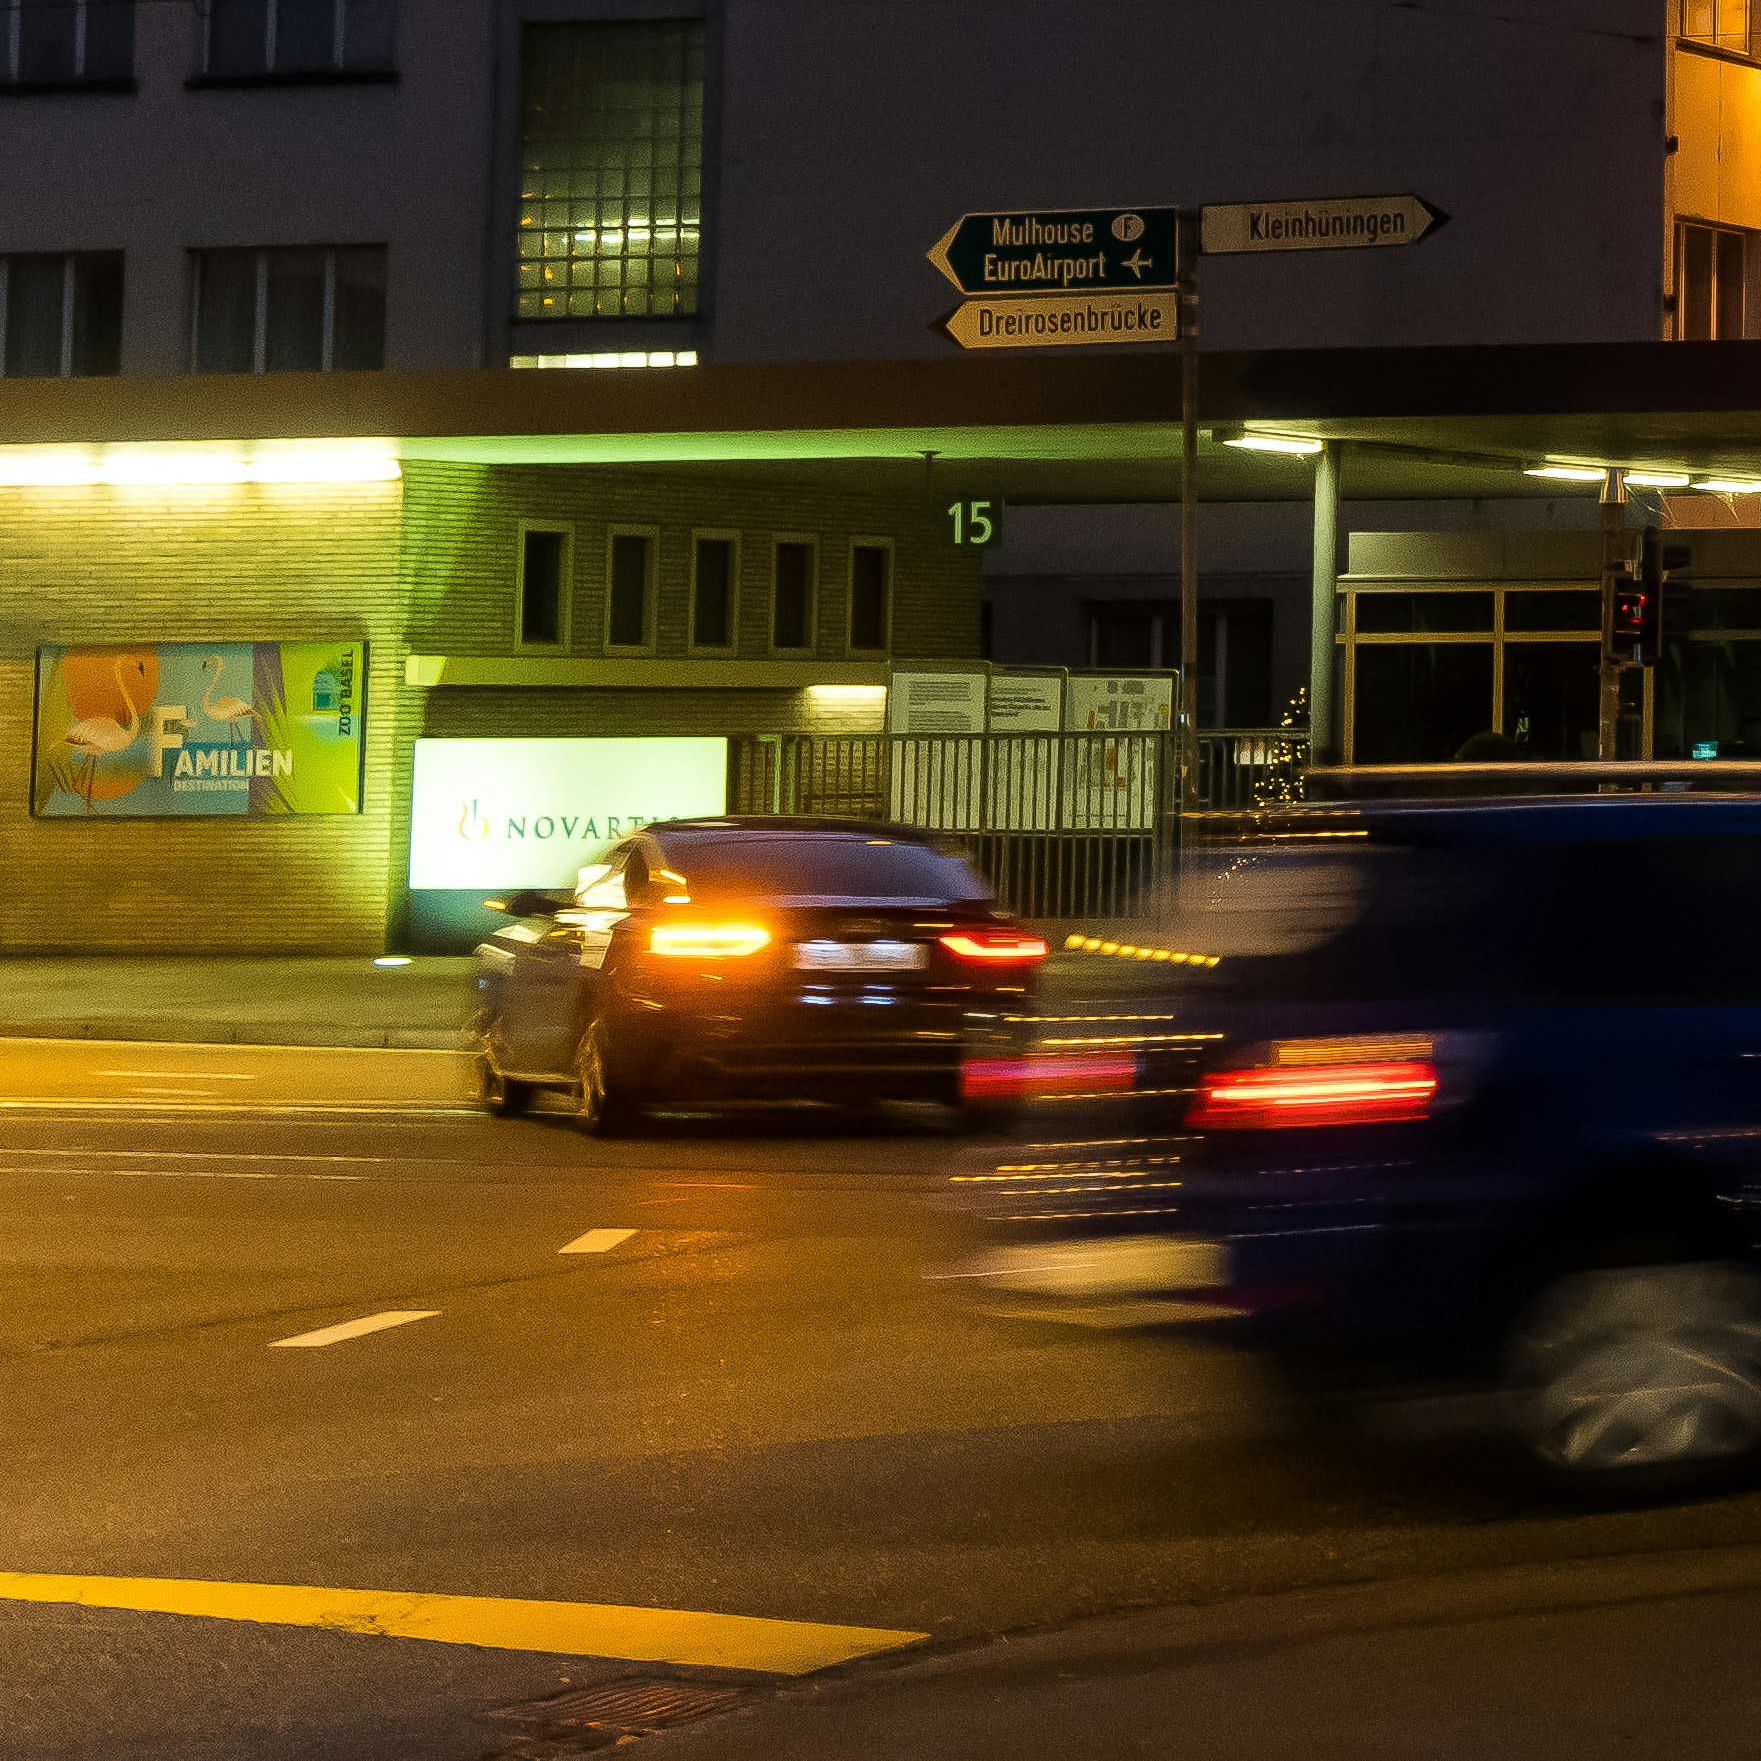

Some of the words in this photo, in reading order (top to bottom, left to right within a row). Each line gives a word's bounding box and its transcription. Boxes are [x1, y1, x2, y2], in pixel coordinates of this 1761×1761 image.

[992, 218, 1094, 246] Mulhouse
[1250, 209, 1405, 243] Kleinhüningen
[984, 251, 1107, 287] EuroAirport
[978, 303, 1163, 338] Dreirosenbrücke
[948, 501, 992, 544] 15
[340, 646, 354, 699] BASEL
[338, 703, 352, 736] ZOO
[151, 704, 293, 777] FAMILIEN
